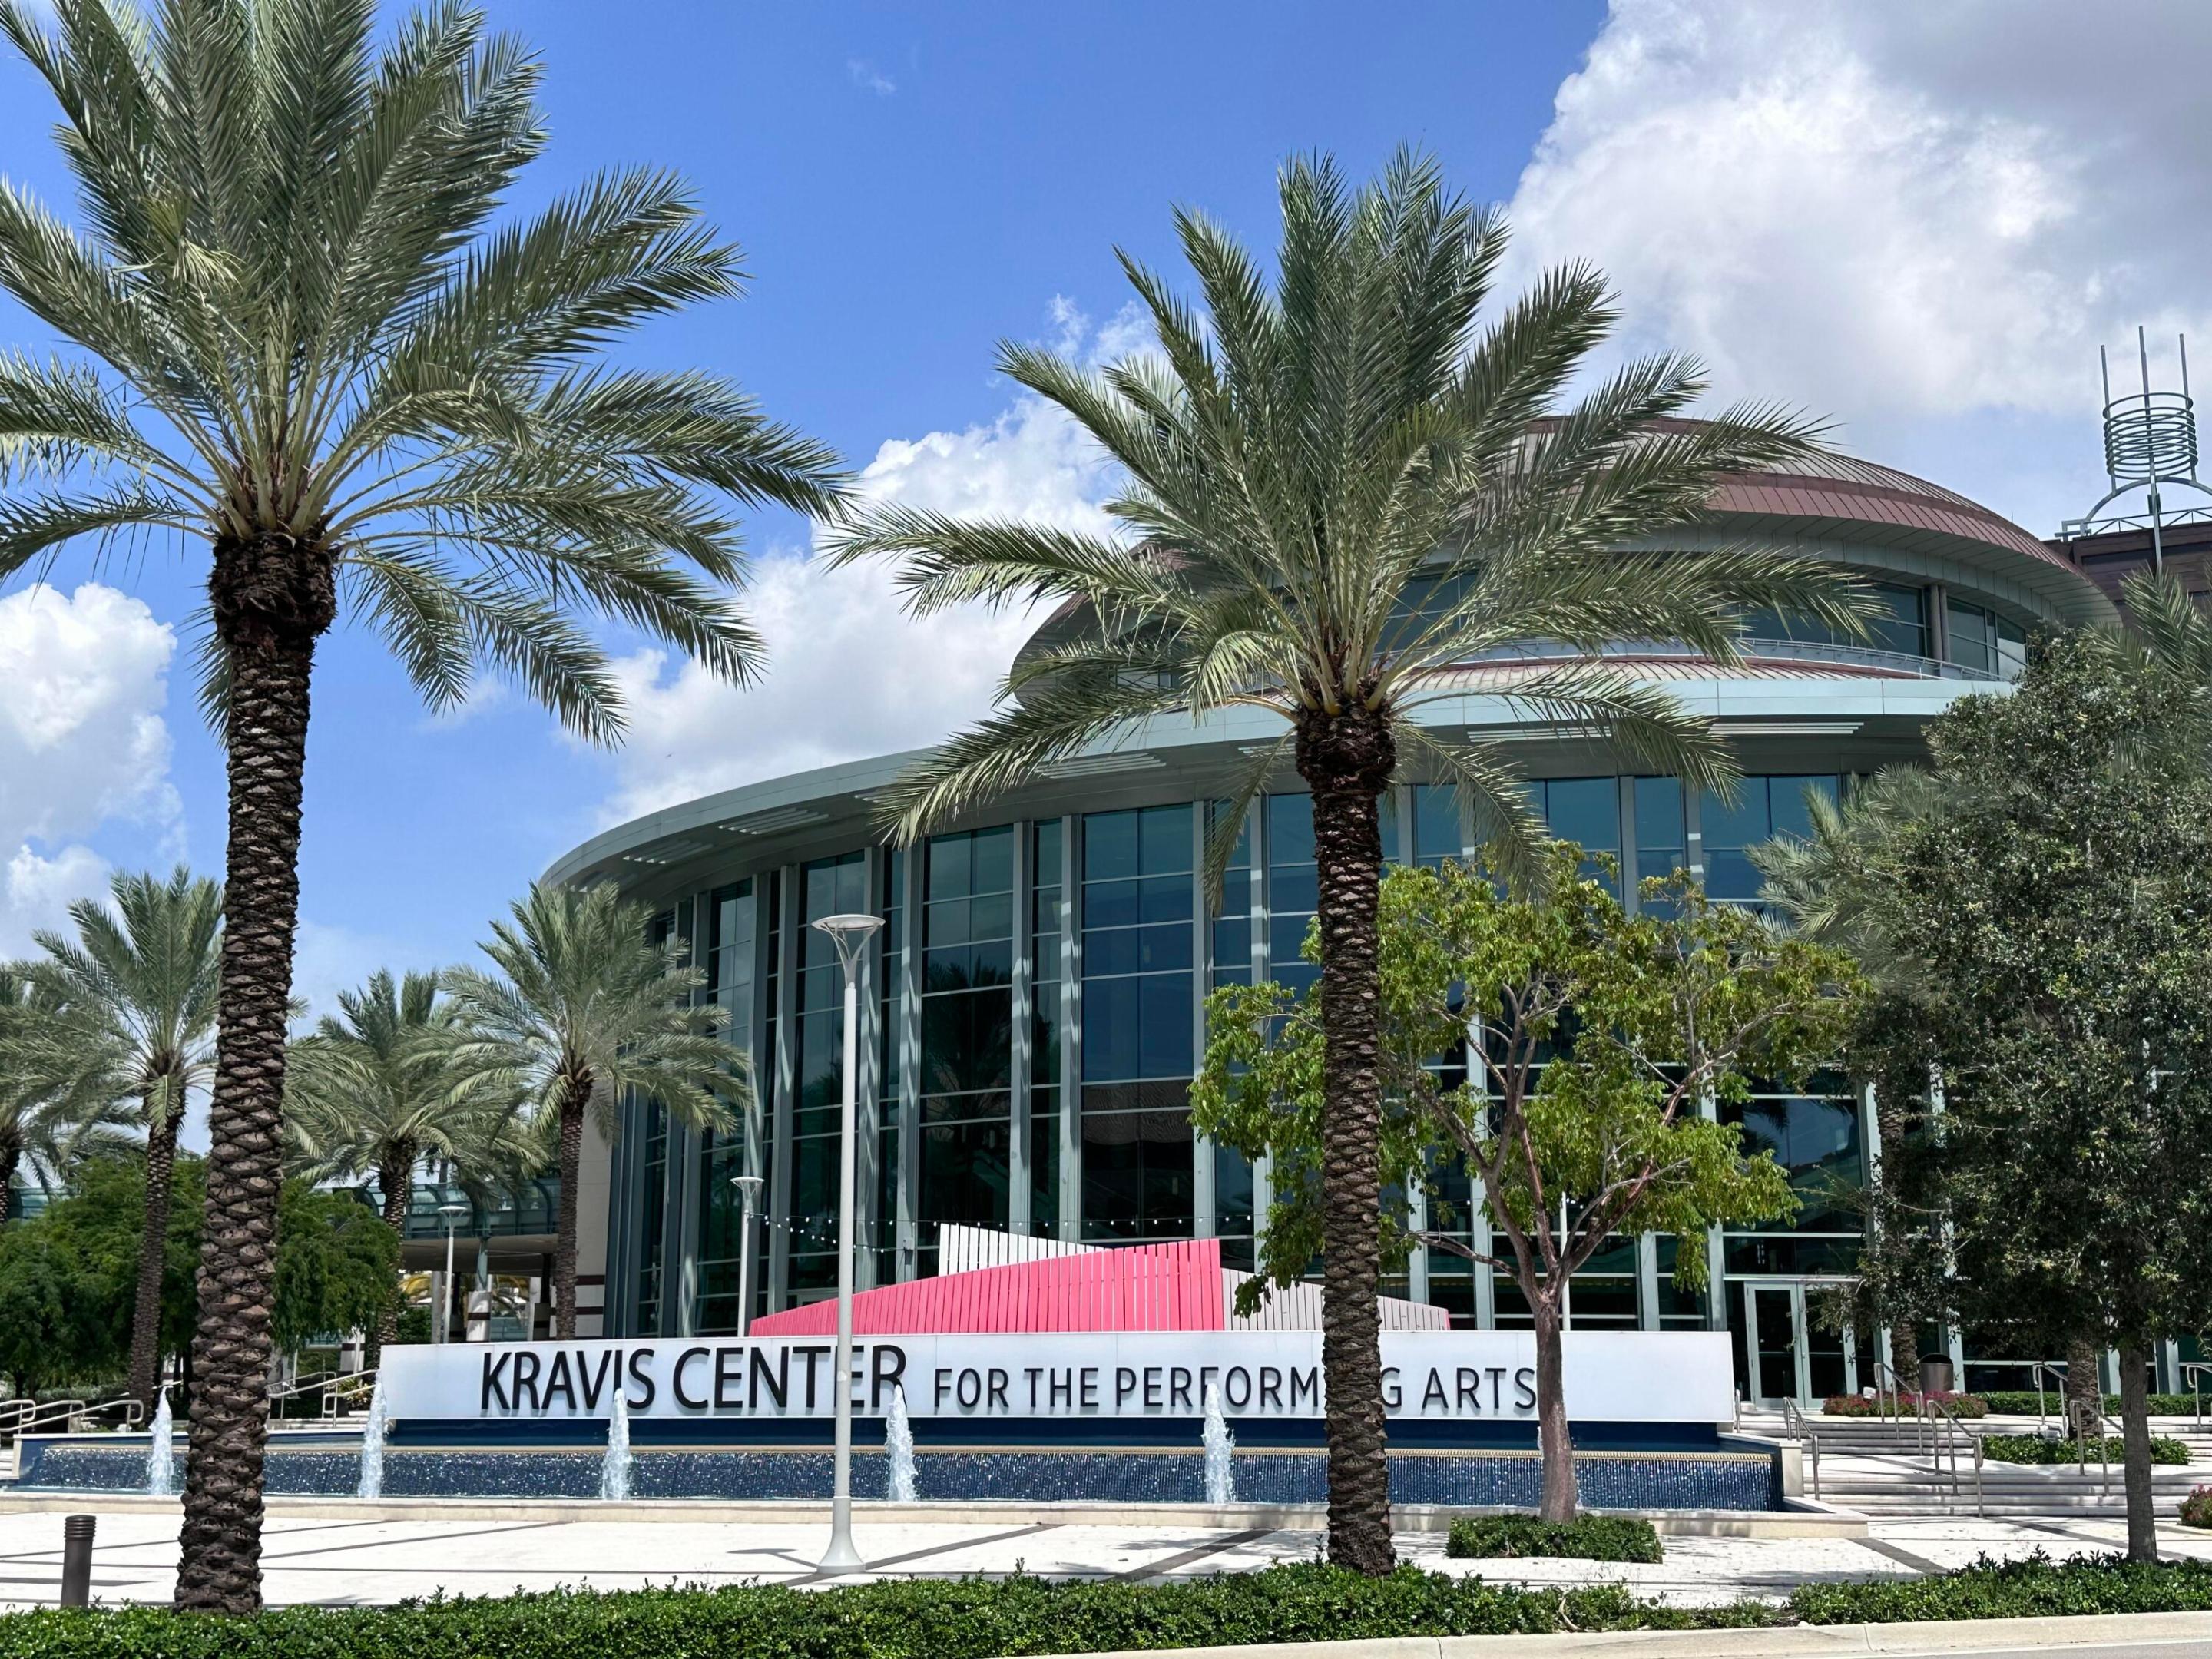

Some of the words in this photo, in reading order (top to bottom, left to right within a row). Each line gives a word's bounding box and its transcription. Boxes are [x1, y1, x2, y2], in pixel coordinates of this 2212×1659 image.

[481, 1348, 656, 1410] KRAVIS
[934, 1368, 1009, 1408] FOR
[1024, 1367, 1099, 1407] THE
[1116, 1366, 1402, 1409] PERFORMG
[1422, 1367, 1537, 1409] ARTS
